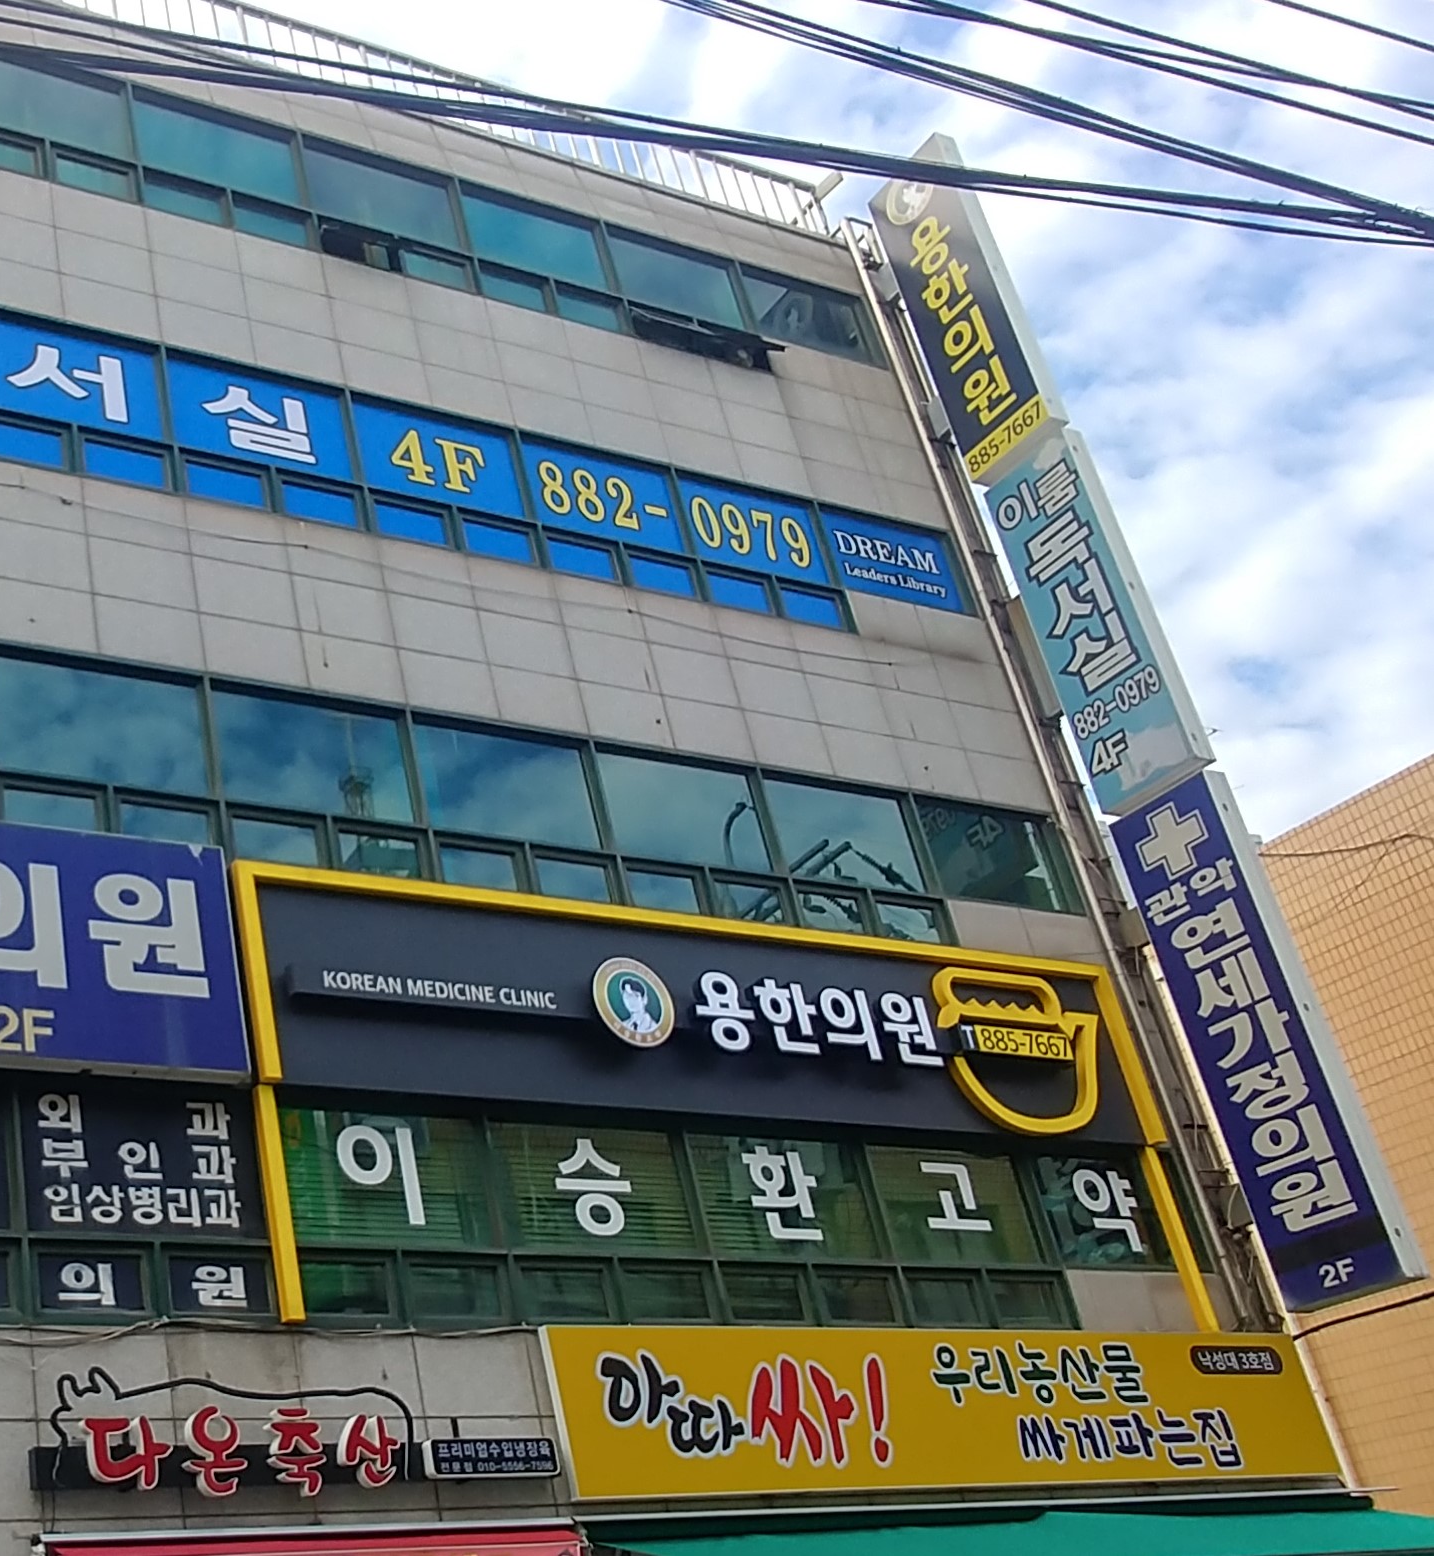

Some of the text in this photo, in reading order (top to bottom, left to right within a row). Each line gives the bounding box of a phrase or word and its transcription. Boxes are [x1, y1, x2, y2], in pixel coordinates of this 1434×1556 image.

[910, 215, 1017, 426] 용한의원
[390, 429, 484, 493] 4F
[968, 400, 1043, 474] 885-7667
[997, 459, 1078, 531] 이룸
[833, 530, 940, 575] DREAM
[844, 562, 947, 599] Leaders Library
[1026, 509, 1141, 695] 독서실
[1073, 665, 1160, 740] 882-0979
[1091, 730, 1128, 777] 4F
[1144, 857, 1235, 928] 관악
[322, 969, 557, 1010] KOREAN MEDICINE CLINIC
[696, 970, 945, 1068] 용한의원
[980, 1028, 1067, 1057] 885-7667
[1171, 897, 1359, 1233] 연세가정의원
[44, 1184, 241, 1228] 임상병리과
[1318, 1257, 1355, 1288] 2F
[1198, 1351, 1239, 1370] 낙성대
[80, 1405, 400, 1498] 다온축산
